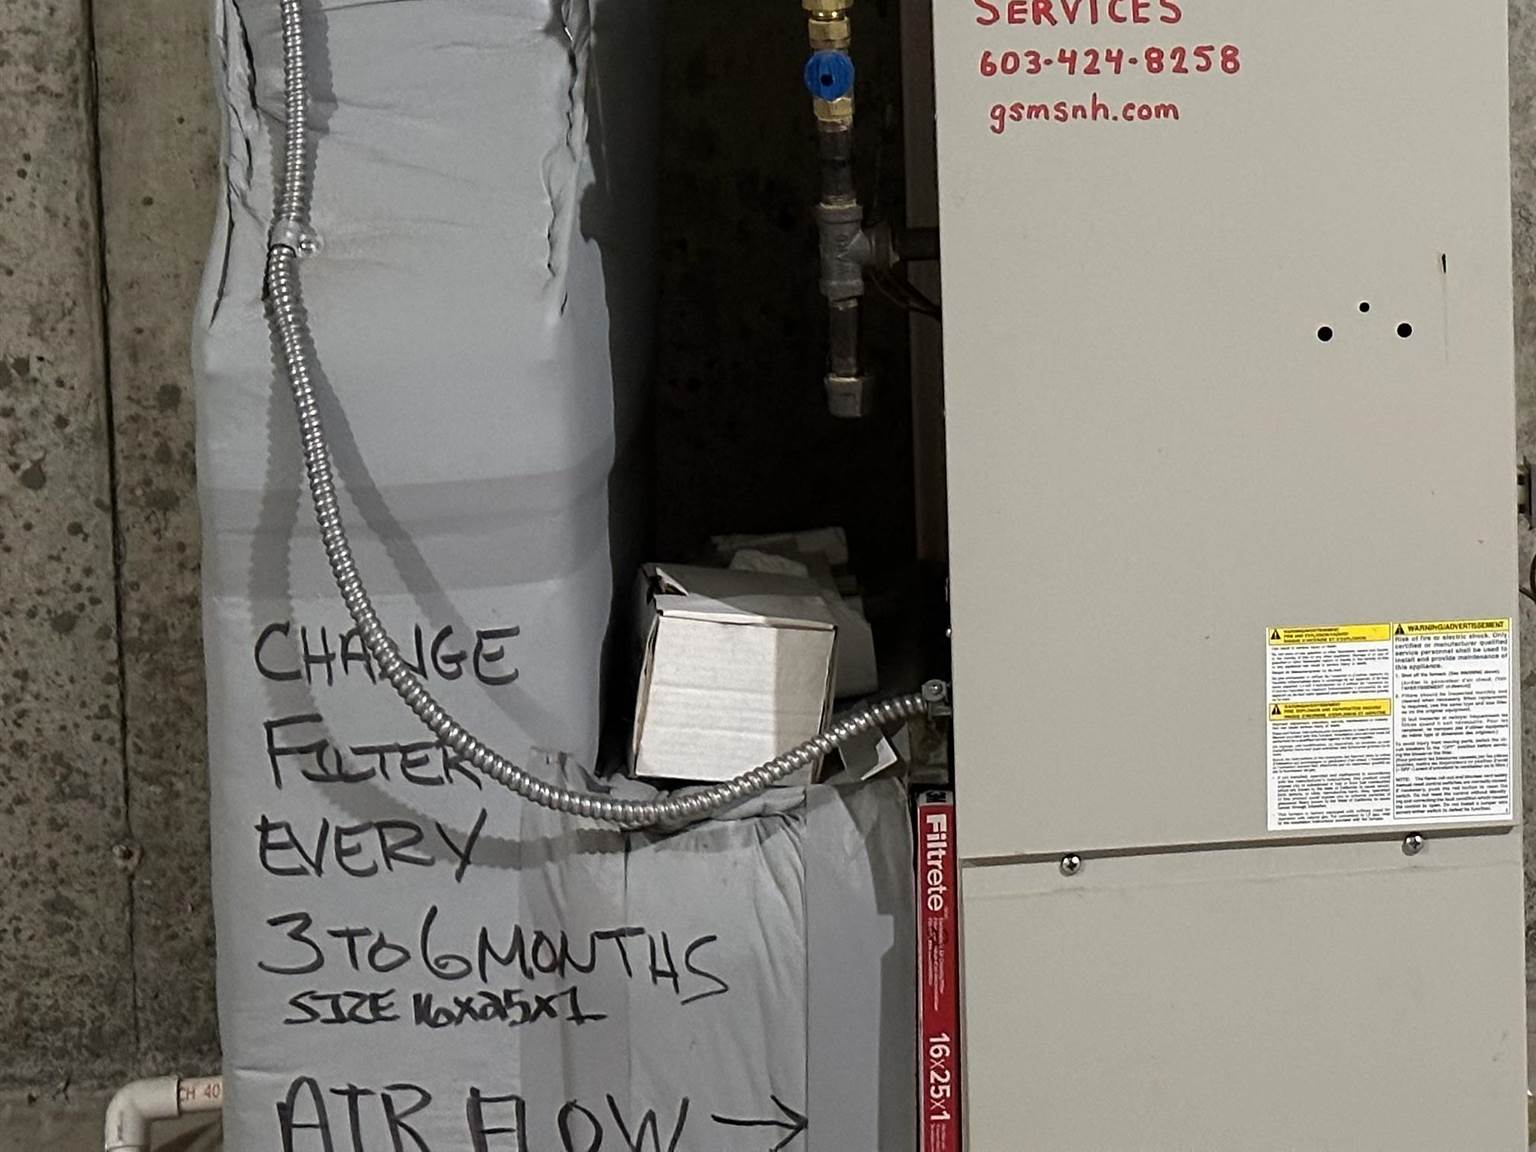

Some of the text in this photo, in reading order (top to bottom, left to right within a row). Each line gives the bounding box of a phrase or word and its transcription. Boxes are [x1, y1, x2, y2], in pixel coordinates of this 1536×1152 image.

[979, 44, 1241, 76] 603-424-8258
[990, 92, 1180, 134] gsmsnh.com
[254, 808, 488, 884] EVERY
[926, 814, 947, 911] Filtrete
[257, 911, 325, 975] 3
[420, 904, 472, 980] 6
[477, 924, 730, 1006] MONTHS
[283, 988, 401, 1026] SIZE
[204, 1083, 220, 1098] 40
[276, 1075, 434, 1152] AIR
[929, 1033, 950, 1120] 16x25x1
